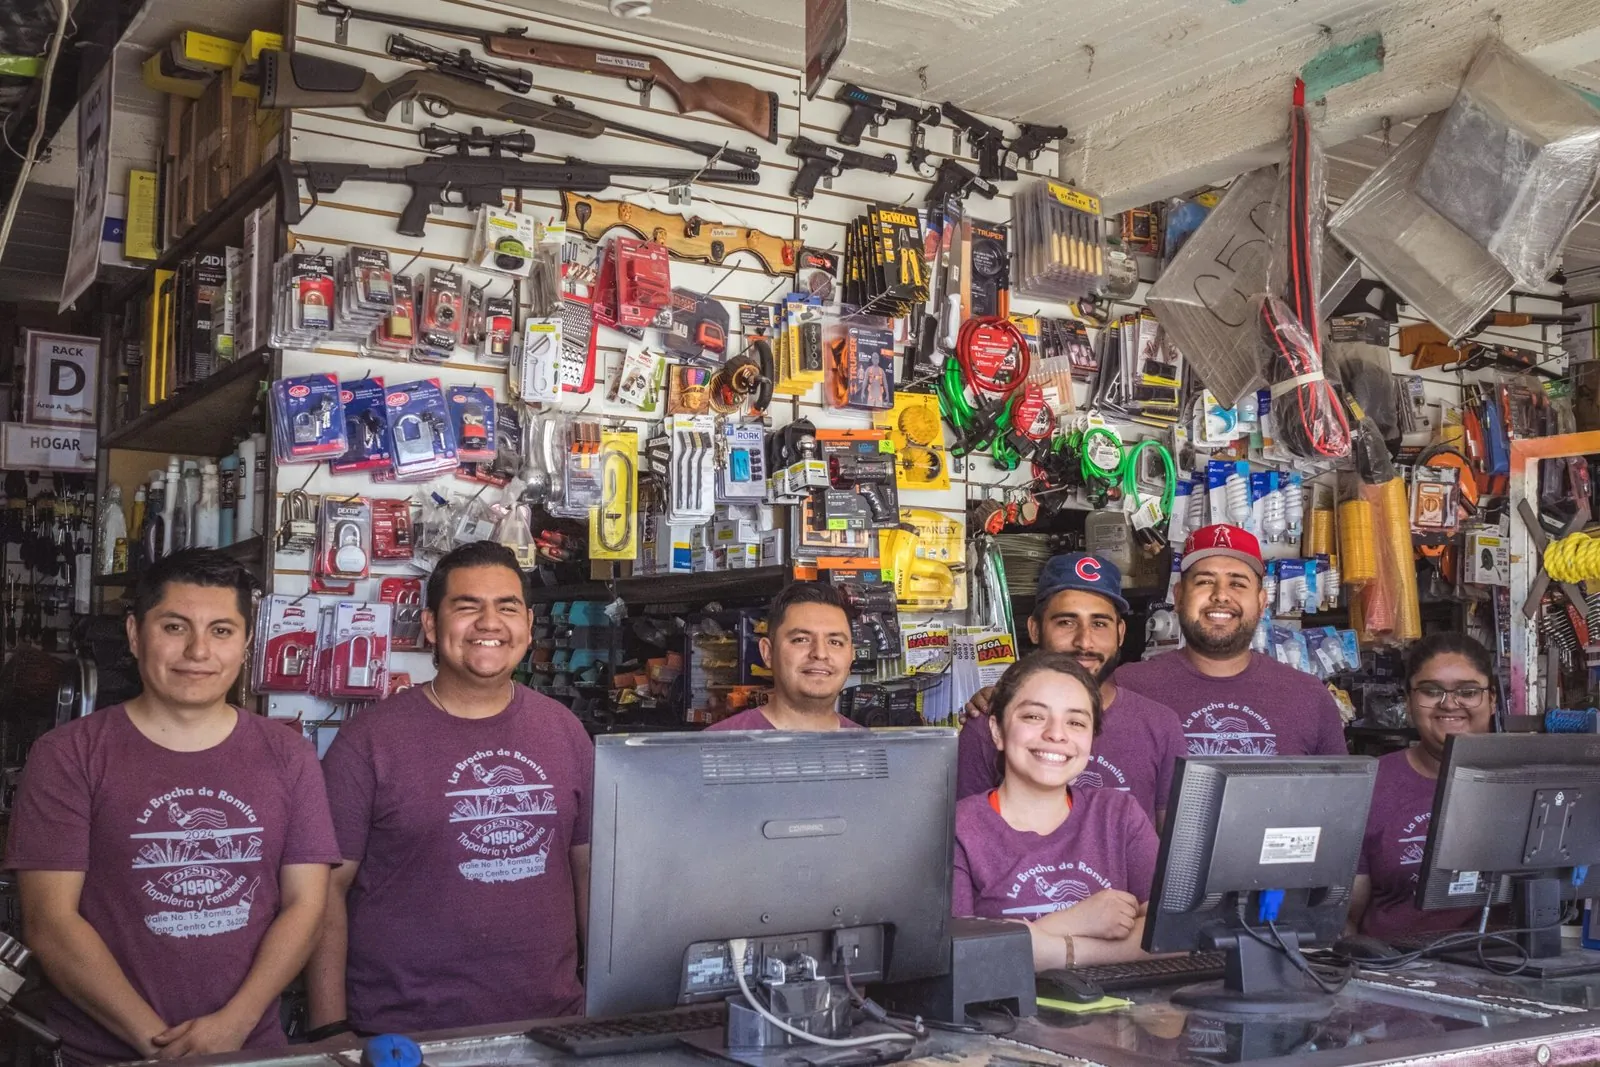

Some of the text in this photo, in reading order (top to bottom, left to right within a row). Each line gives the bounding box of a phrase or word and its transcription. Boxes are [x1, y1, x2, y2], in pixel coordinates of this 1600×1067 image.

[1060, 193, 1086, 206] STANLEY
[880, 210, 918, 228] DEWALT
[977, 228, 1005, 241] TRUPER
[52, 344, 84, 357] RACK
[849, 337, 857, 380] TRUPER
[48, 358, 86, 397] D
[30, 436, 81, 451] HOGAR
[917, 525, 957, 535] STANLEY
[1212, 524, 1233, 549] A
[1074, 556, 1101, 582] C
[908, 632, 928, 641] PEGA
[976, 640, 1001, 651] PEGA
[978, 646, 1013, 662] RATA
[1182, 702, 1271, 731] La Brocha de Romita
[447, 748, 548, 785] La Brocha de Romita
[1096, 755, 1127, 785] Romita
[489, 785, 515, 796] 2024
[136, 786, 258, 824] La Brocha de Romita
[482, 818, 524, 834] DESDE
[1403, 812, 1432, 834] La Bro
[184, 829, 215, 840] 2024
[489, 829, 518, 846] 1950
[502, 849, 508, 858] y
[460, 862, 479, 870] Valle
[485, 870, 510, 878] Centro
[172, 866, 221, 883] DESDE
[1006, 861, 1113, 899] La Brocha de Romit
[179, 878, 215, 896] 1950
[197, 900, 205, 910] y
[145, 914, 169, 924] Valle
[151, 925, 175, 935] Zona
[176, 922, 206, 932] Centro
